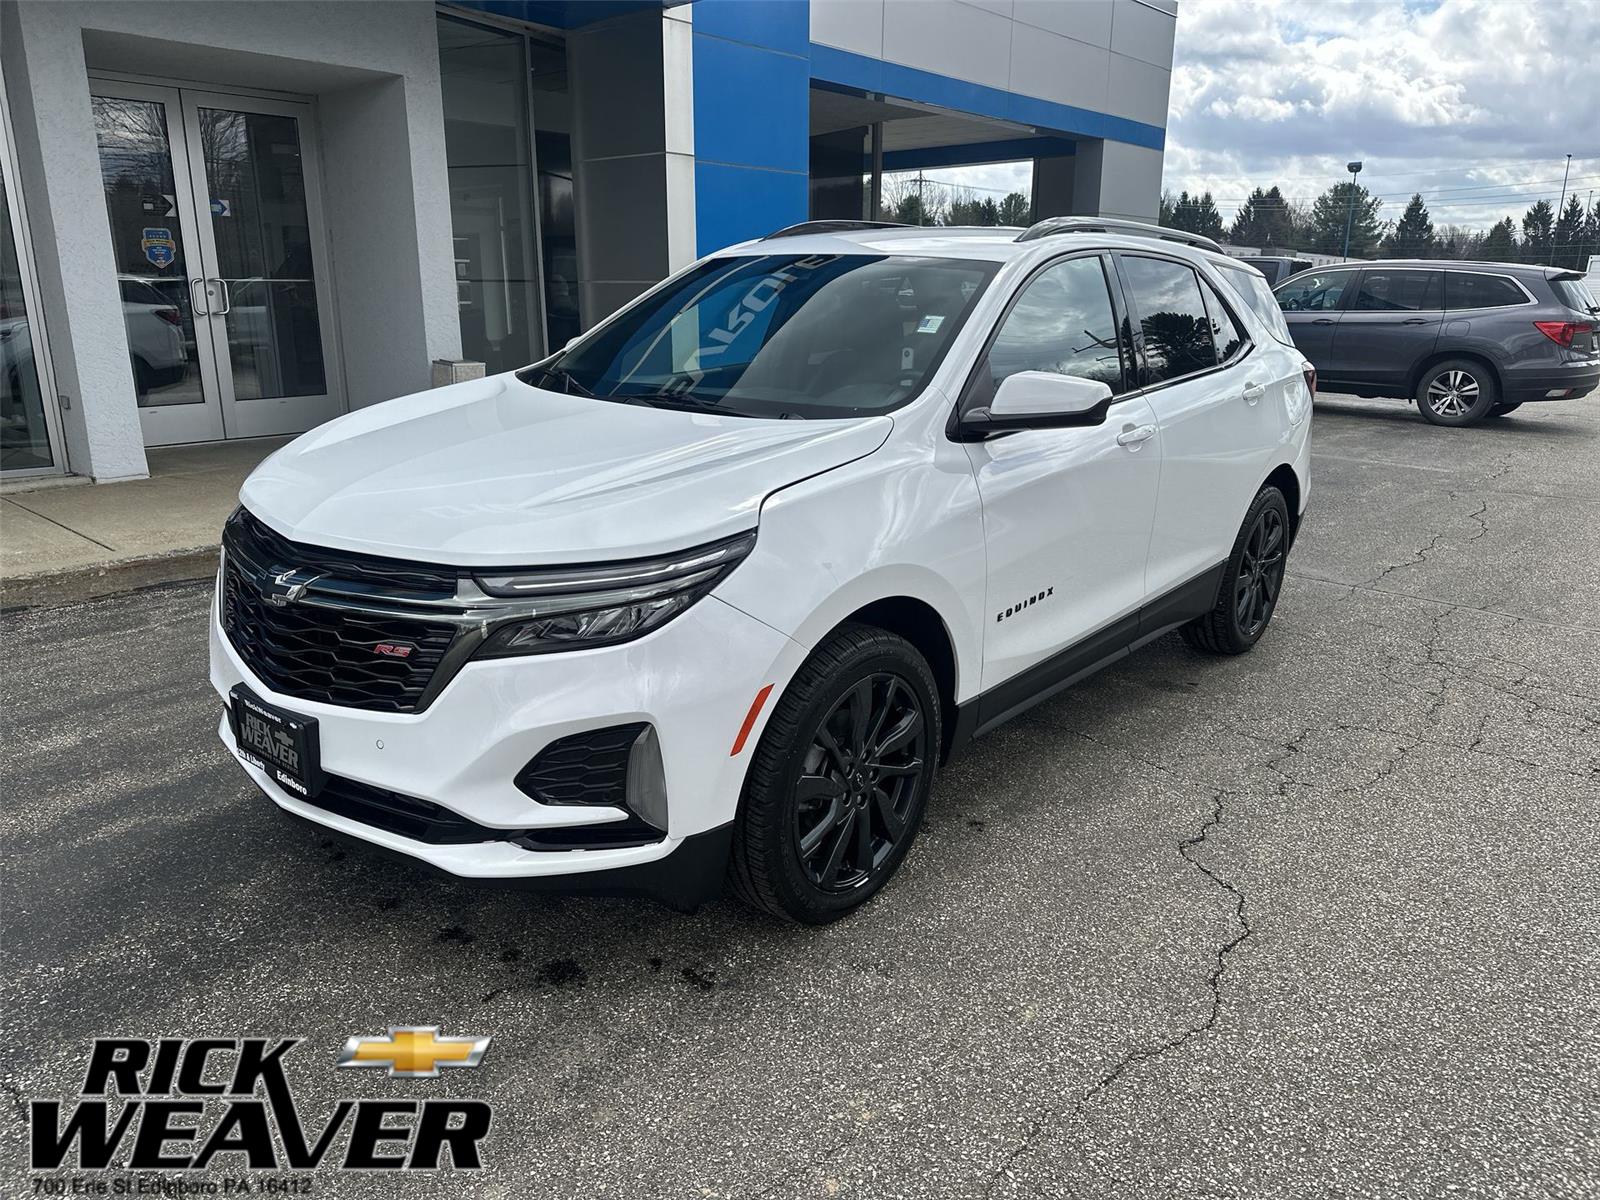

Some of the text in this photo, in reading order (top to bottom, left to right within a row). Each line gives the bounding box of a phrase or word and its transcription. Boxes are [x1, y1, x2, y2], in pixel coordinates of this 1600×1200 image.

[997, 586, 1054, 622] EQUINOX
[374, 644, 412, 657] RS
[245, 712, 271, 737] RICK
[240, 722, 299, 769] WEAVER
[276, 770, 307, 795] Edinboro
